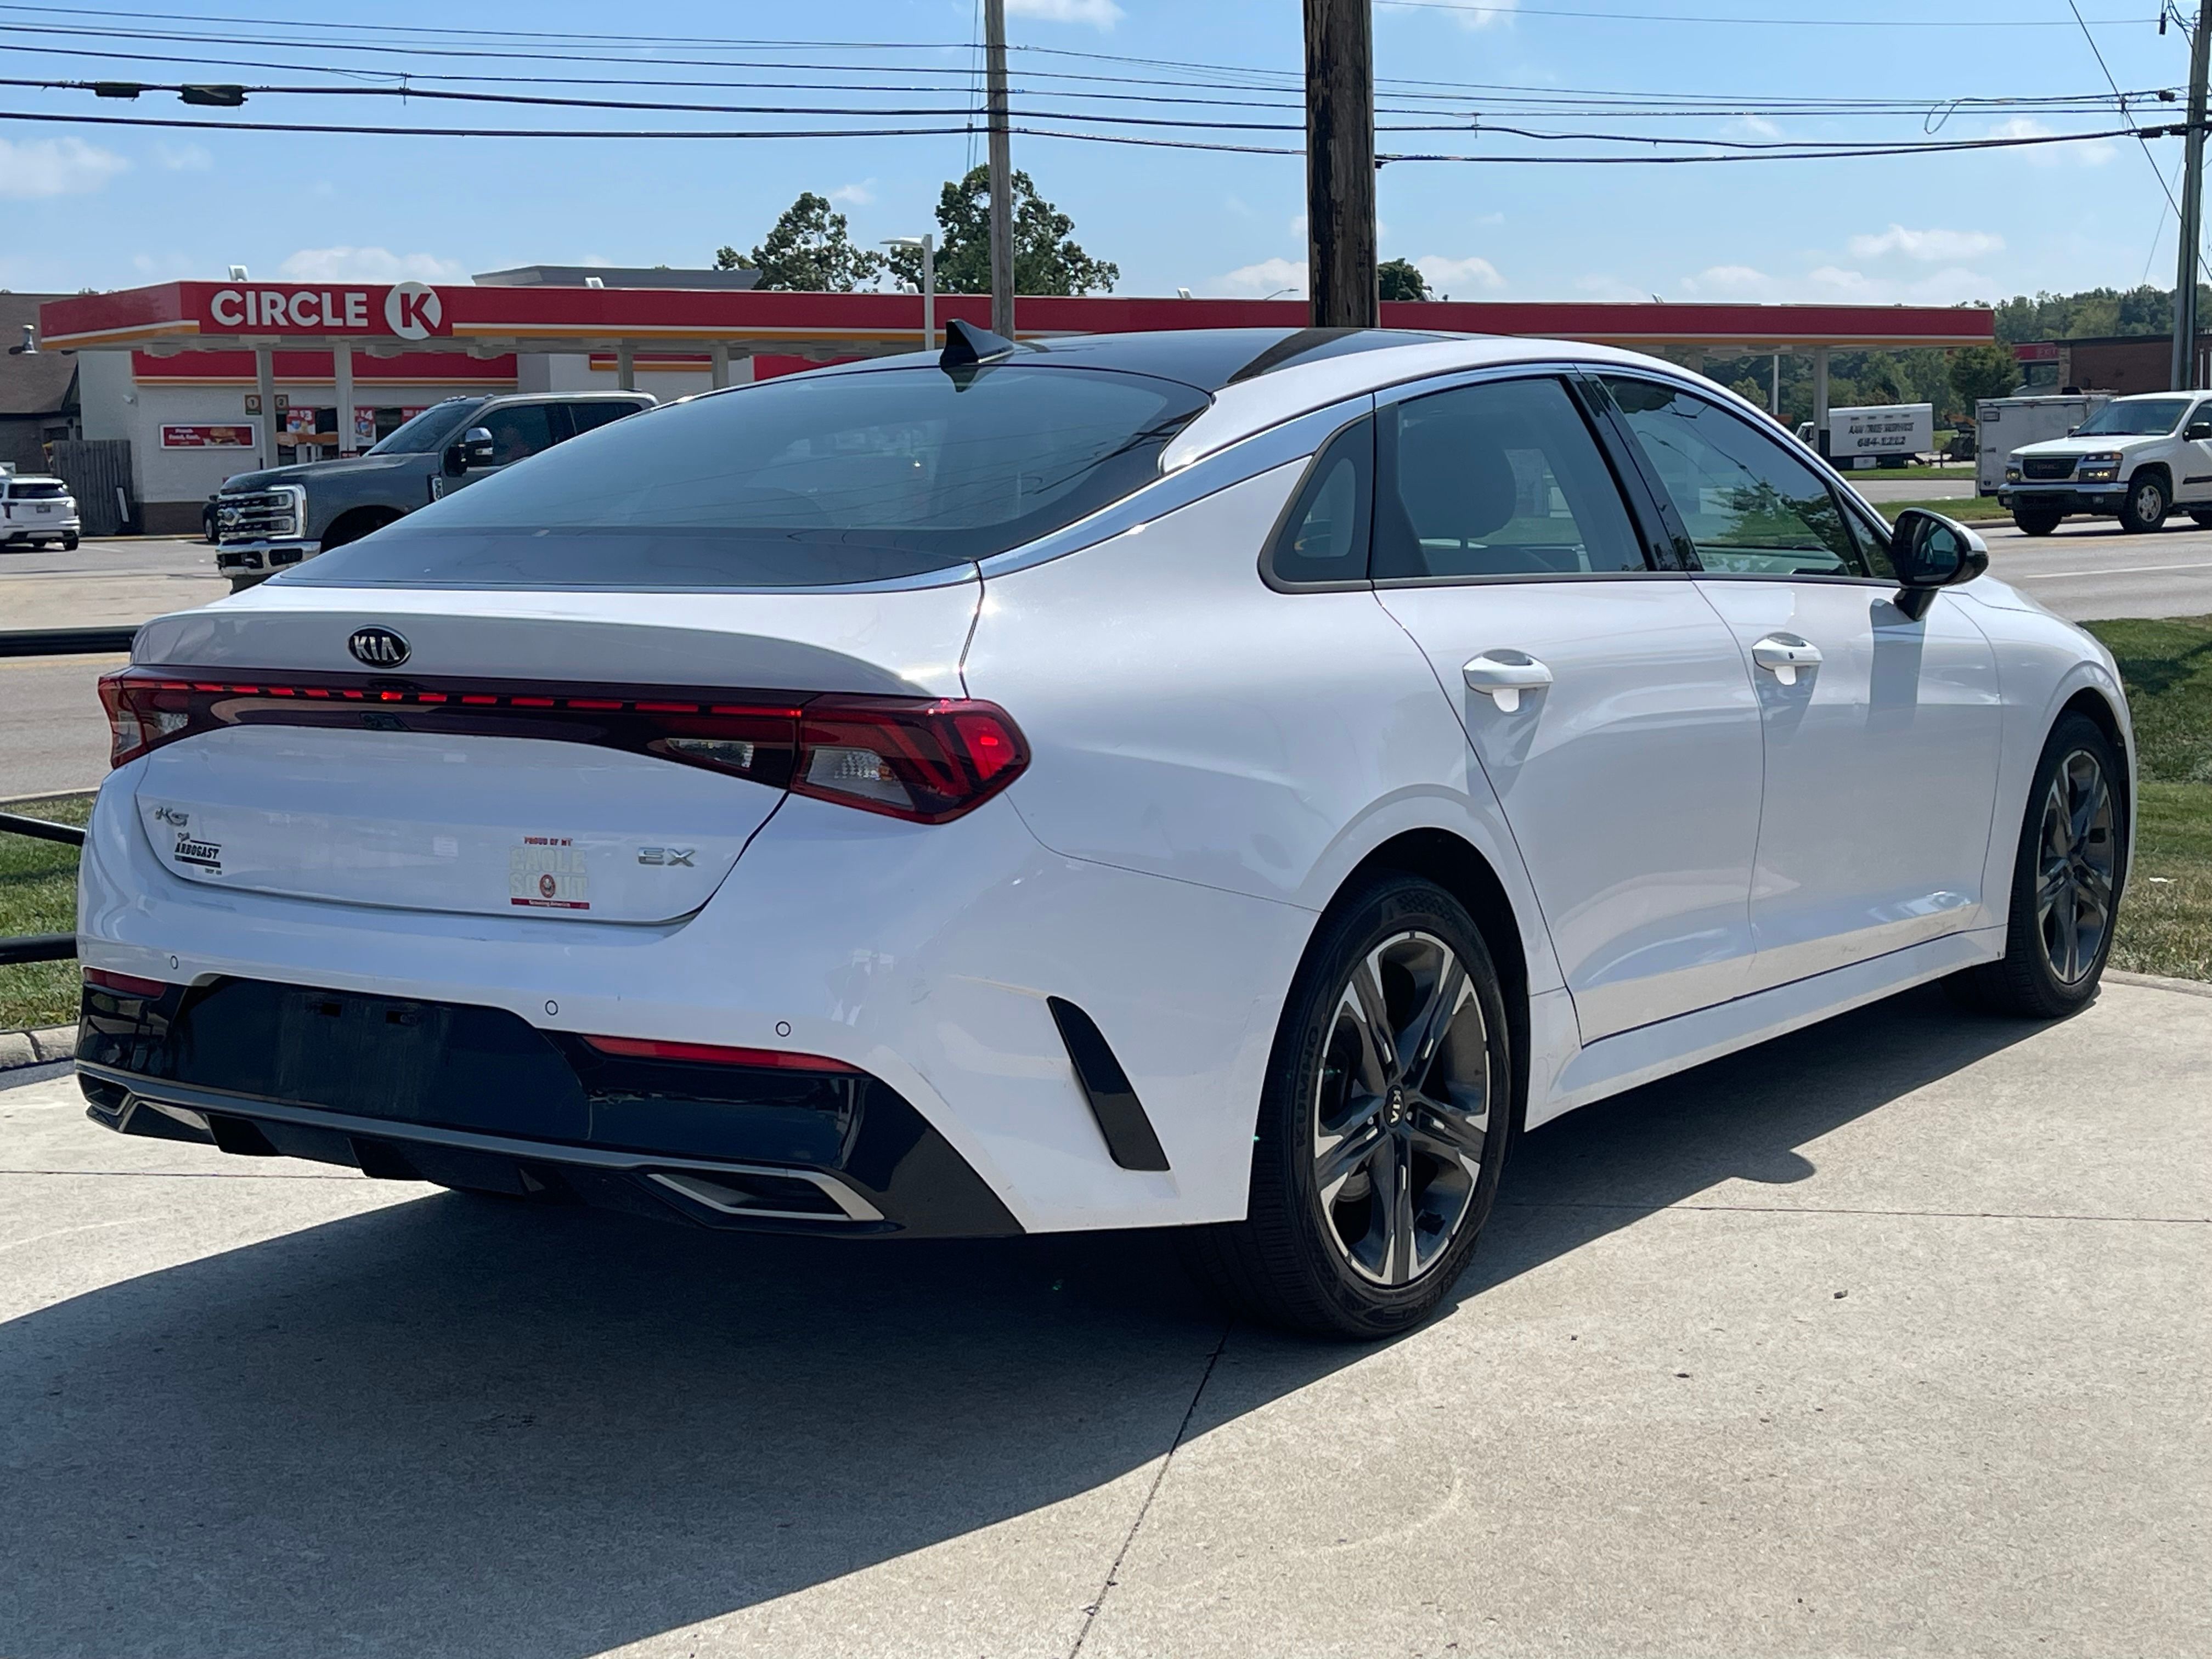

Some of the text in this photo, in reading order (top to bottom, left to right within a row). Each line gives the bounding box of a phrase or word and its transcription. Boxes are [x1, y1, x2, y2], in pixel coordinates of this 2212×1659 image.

[211, 290, 438, 328] CIRCLE K
[353, 635, 399, 661] KIA
[174, 843, 219, 859] ARBOGAST
[509, 846, 586, 873] EAGLE
[638, 847, 695, 867] EX
[1295, 1025, 1319, 1148] KUMHO
[1390, 1090, 1401, 1123] KIA
